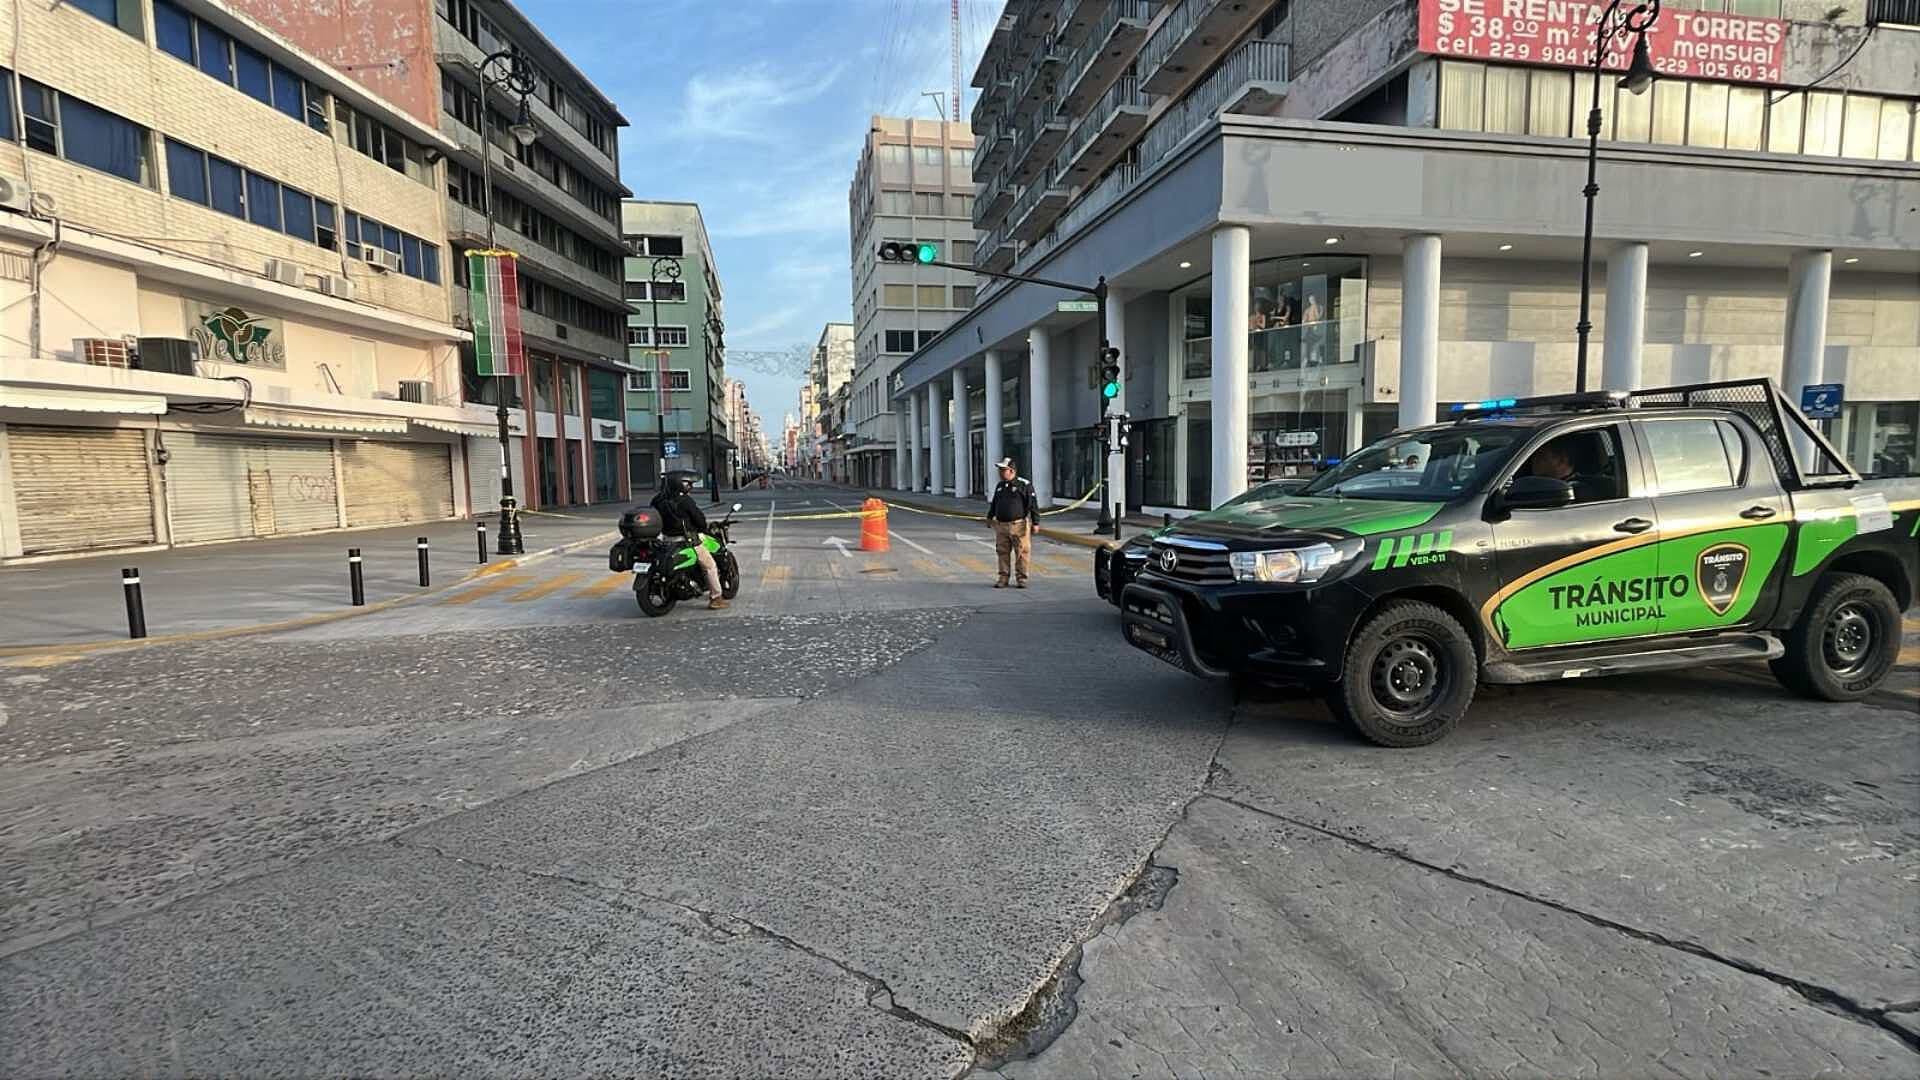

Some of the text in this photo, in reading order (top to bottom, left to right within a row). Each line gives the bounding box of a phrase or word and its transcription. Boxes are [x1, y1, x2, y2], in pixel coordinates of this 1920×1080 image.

[1437, 12, 1455, 36] $
[1673, 40, 1774, 64] mensual
[1439, 0, 1485, 15] SE
[1502, 0, 1604, 26] RENTA
[1673, 14, 1782, 44] TORRES
[1436, 37, 1479, 55] cel.
[1489, 42, 1530, 59] 229
[1541, 47, 1577, 63] 984
[1607, 51, 1625, 68] 01
[1656, 57, 1688, 73] 229
[1698, 61, 1728, 77] 105
[1732, 64, 1751, 79] 60
[1757, 66, 1779, 82] 34
[1548, 574, 1690, 610] TRÁNSITO
[1576, 604, 1666, 627] MUNICIPAL
